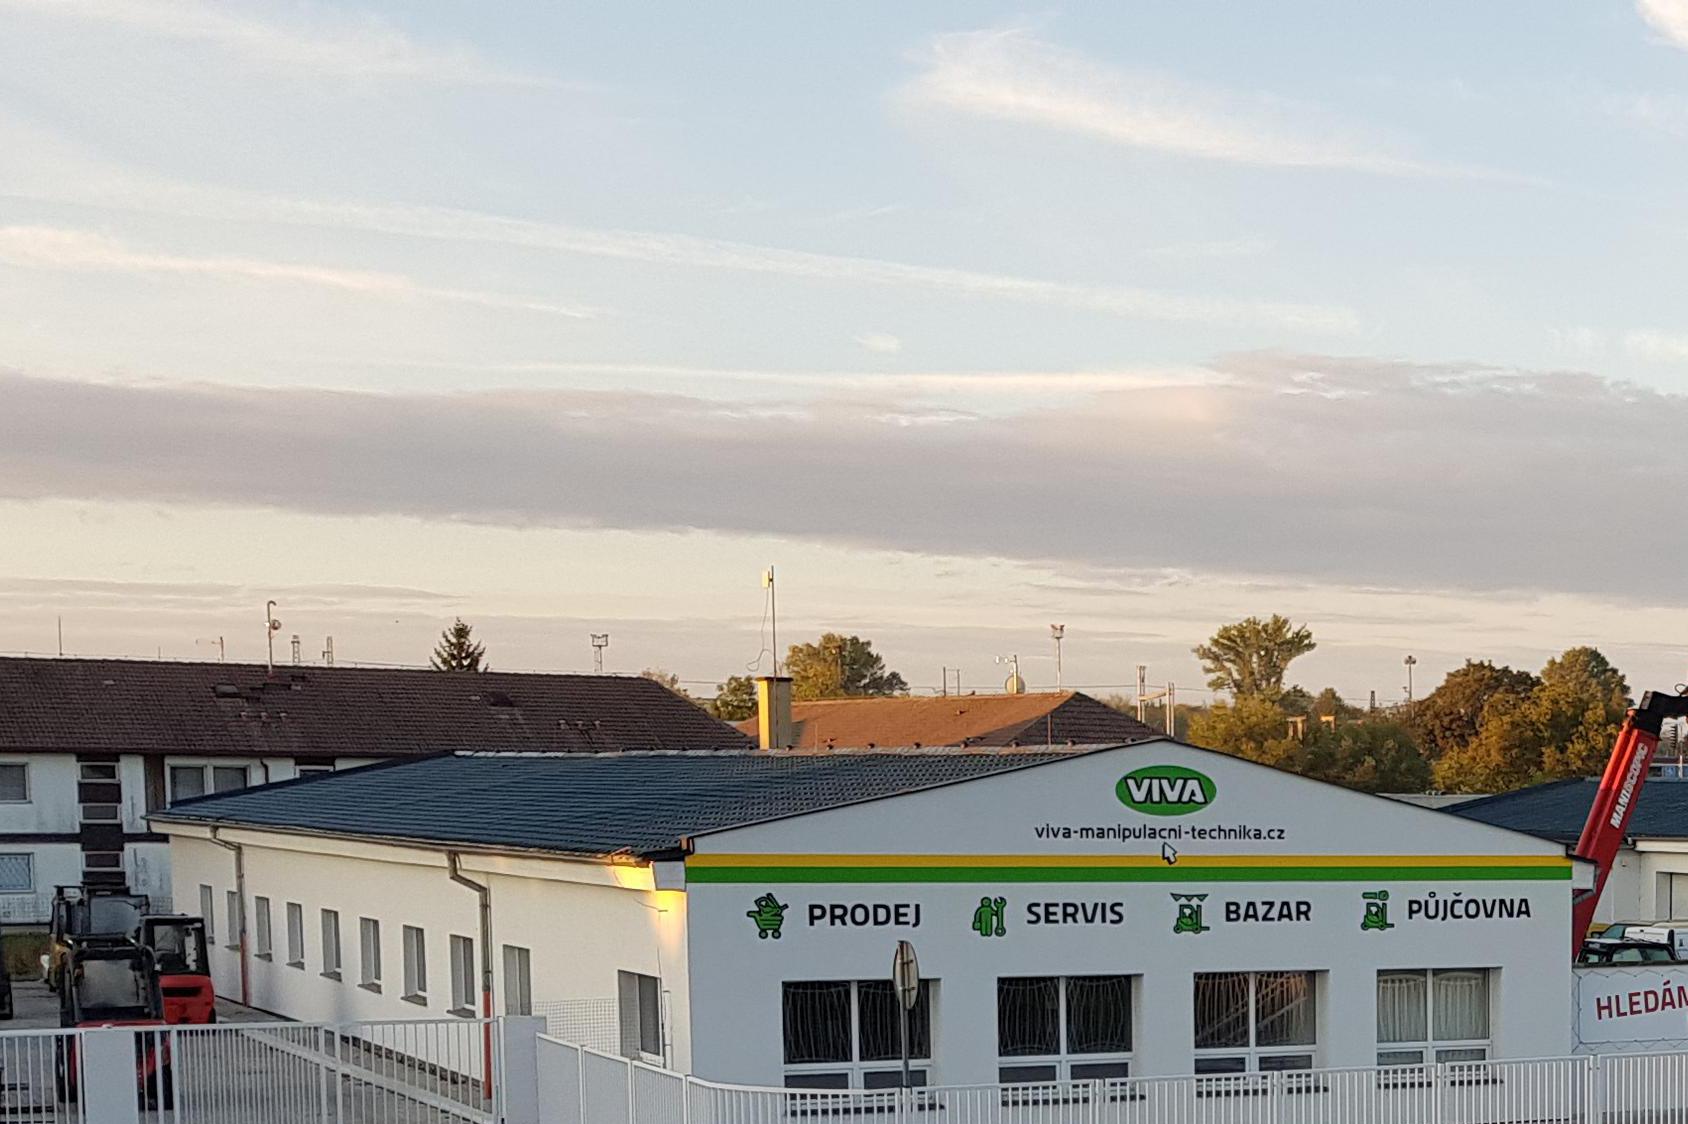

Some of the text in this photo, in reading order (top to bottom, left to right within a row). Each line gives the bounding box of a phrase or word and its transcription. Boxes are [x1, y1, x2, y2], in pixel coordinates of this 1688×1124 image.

[1125, 777, 1209, 804] VIVA
[1034, 823, 1286, 843] viva-manipulacni-technika.cz
[808, 891, 1531, 928] PRODEJ SERVIS BAZAR PŮJČOVNA
